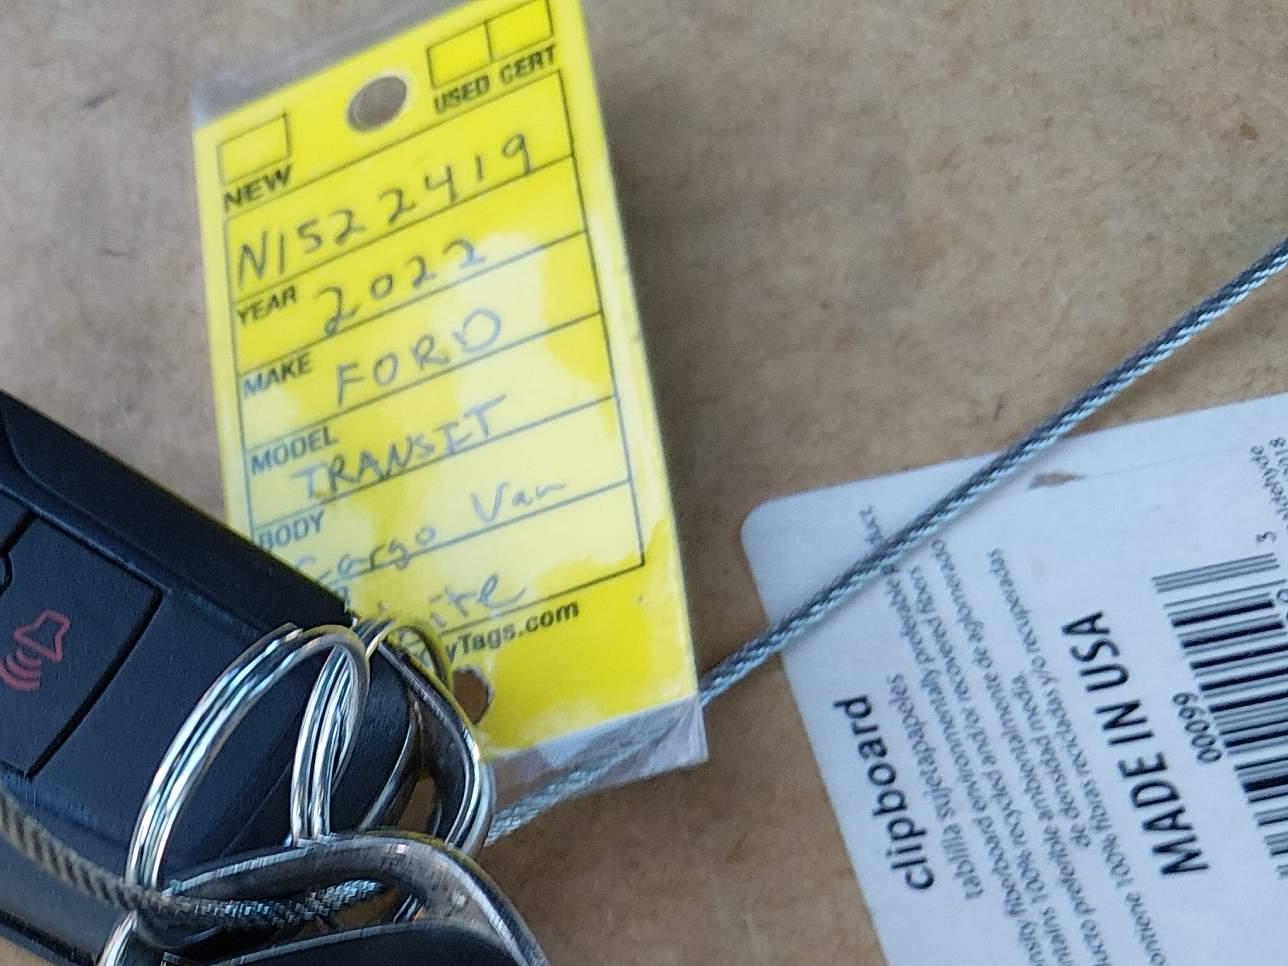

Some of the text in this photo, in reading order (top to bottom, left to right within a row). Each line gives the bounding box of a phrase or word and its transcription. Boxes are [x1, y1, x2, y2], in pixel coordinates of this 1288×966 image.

[434, 44, 557, 114] USED CERT
[223, 164, 293, 212] NEW
[237, 286, 299, 328] YEAR
[317, 239, 486, 338] 2022
[242, 353, 312, 400] MAKE
[335, 308, 502, 409] FORD
[250, 428, 340, 476] MODEL
[289, 395, 509, 500] TRANSIT
[259, 510, 326, 553] BODY
[470, 480, 567, 525] Van
[886, 578, 935, 664] preferable
[926, 538, 983, 643] aglomerado
[445, 599, 581, 664] yTags.com
[921, 616, 970, 702] recovered
[972, 645, 993, 669] de
[920, 669, 987, 813] environmentally
[961, 707, 996, 765] and/or
[983, 672, 1053, 821] ambientalmente
[1062, 611, 1208, 875] MADE IN USA
[1172, 692, 1222, 763] 00099
[833, 695, 934, 890] clipboard
[886, 674, 984, 900] tablilla sujetapapeles
[981, 769, 1027, 847] recycled
[1030, 734, 1079, 819] densidad
[1081, 778, 1111, 833] fibras
[972, 815, 1026, 916] fiberboard
[1069, 823, 1091, 848] de
[1101, 833, 1133, 888] 100%
[1016, 848, 1048, 904] 100%
